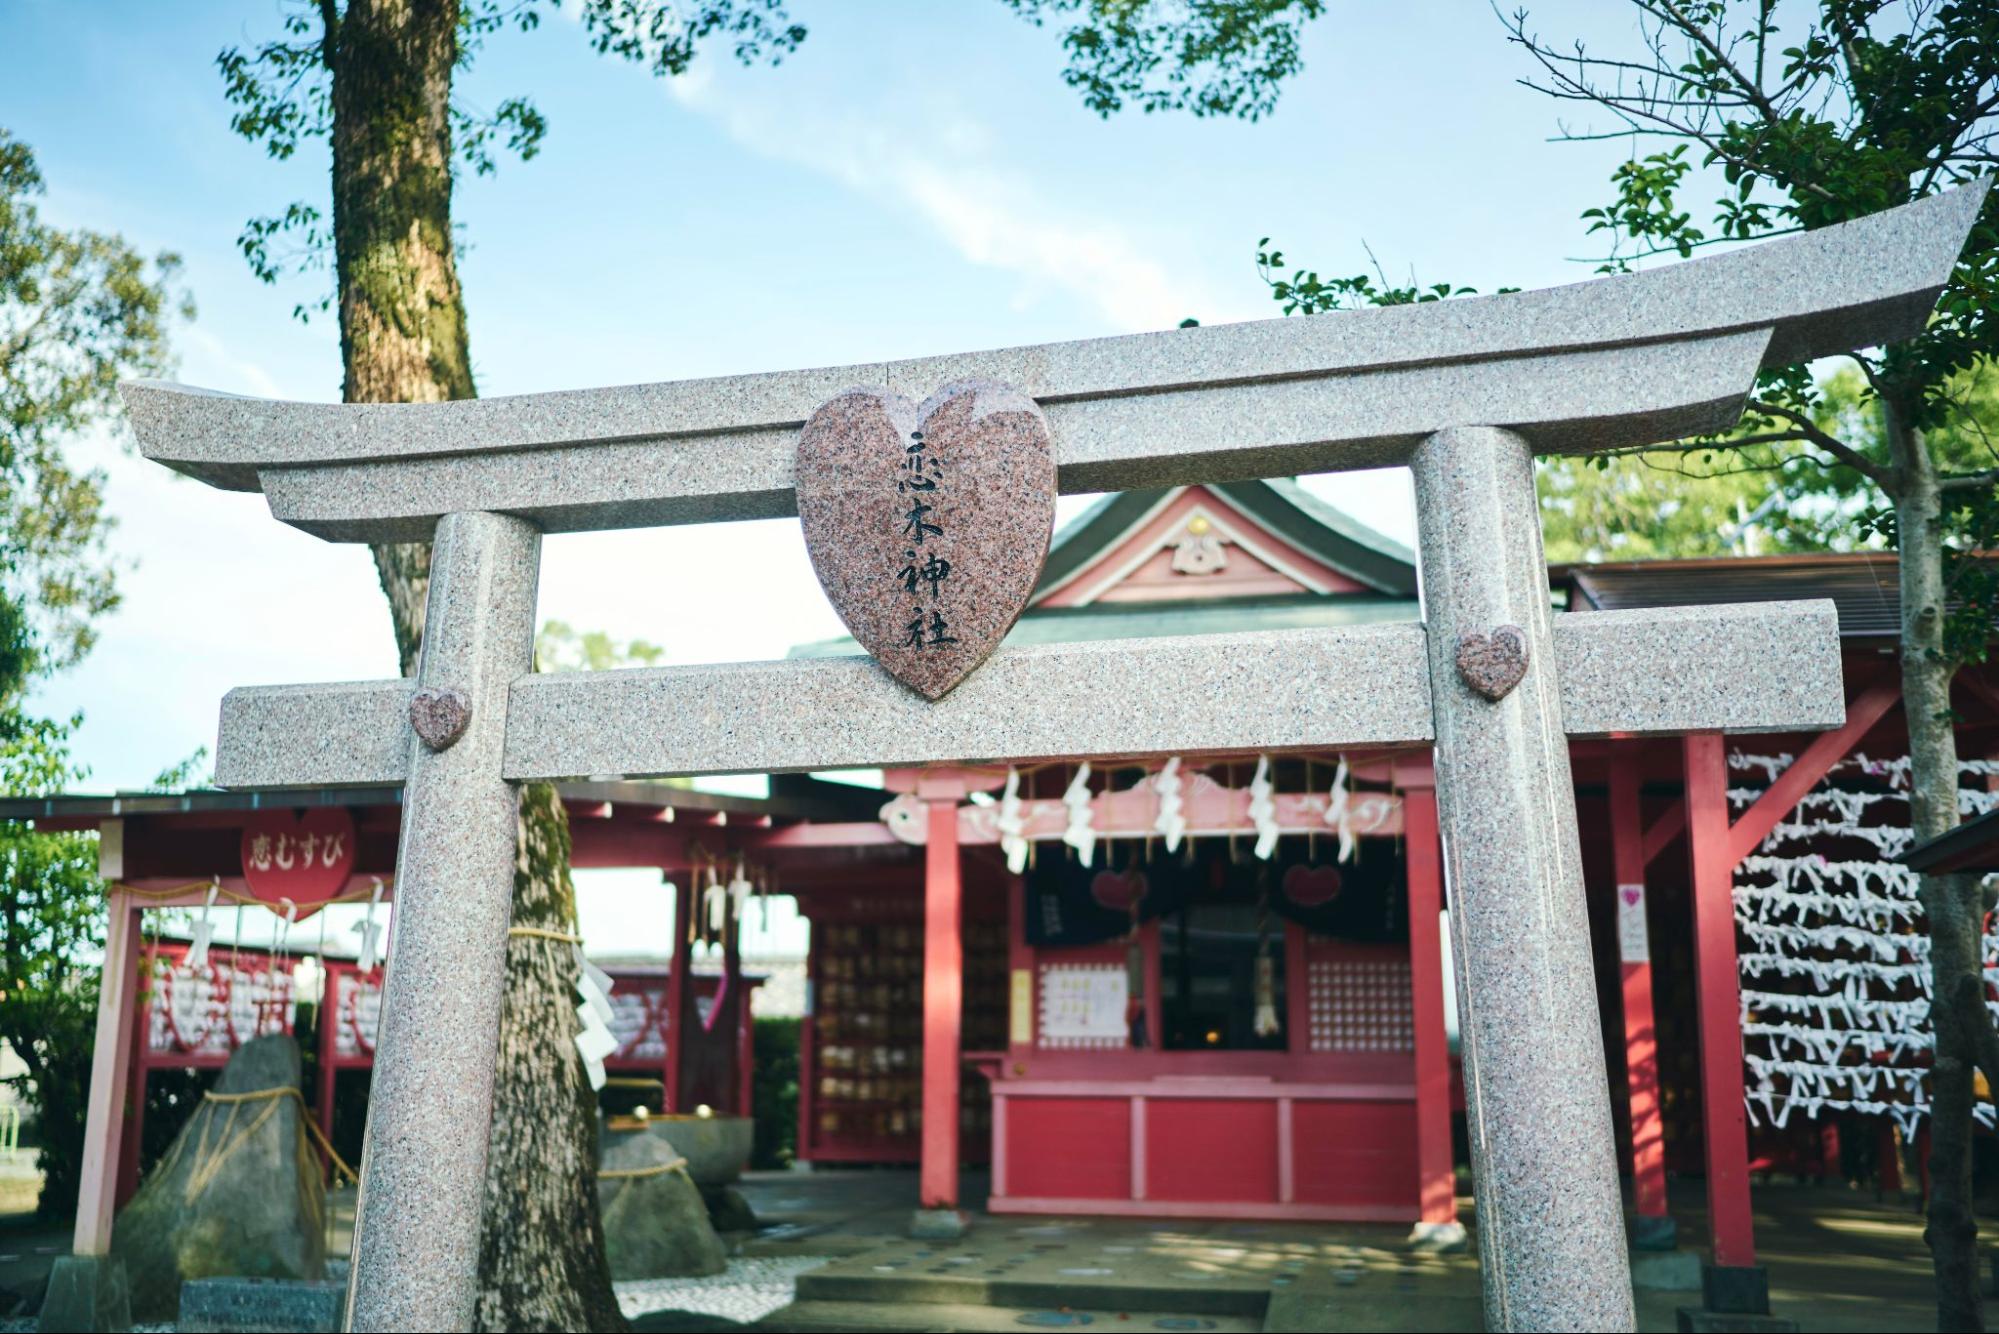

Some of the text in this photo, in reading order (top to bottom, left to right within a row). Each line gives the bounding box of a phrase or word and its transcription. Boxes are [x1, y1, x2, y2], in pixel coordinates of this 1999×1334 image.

[898, 431, 958, 651] 恋木神社
[249, 832, 346, 871] 恋むすび
